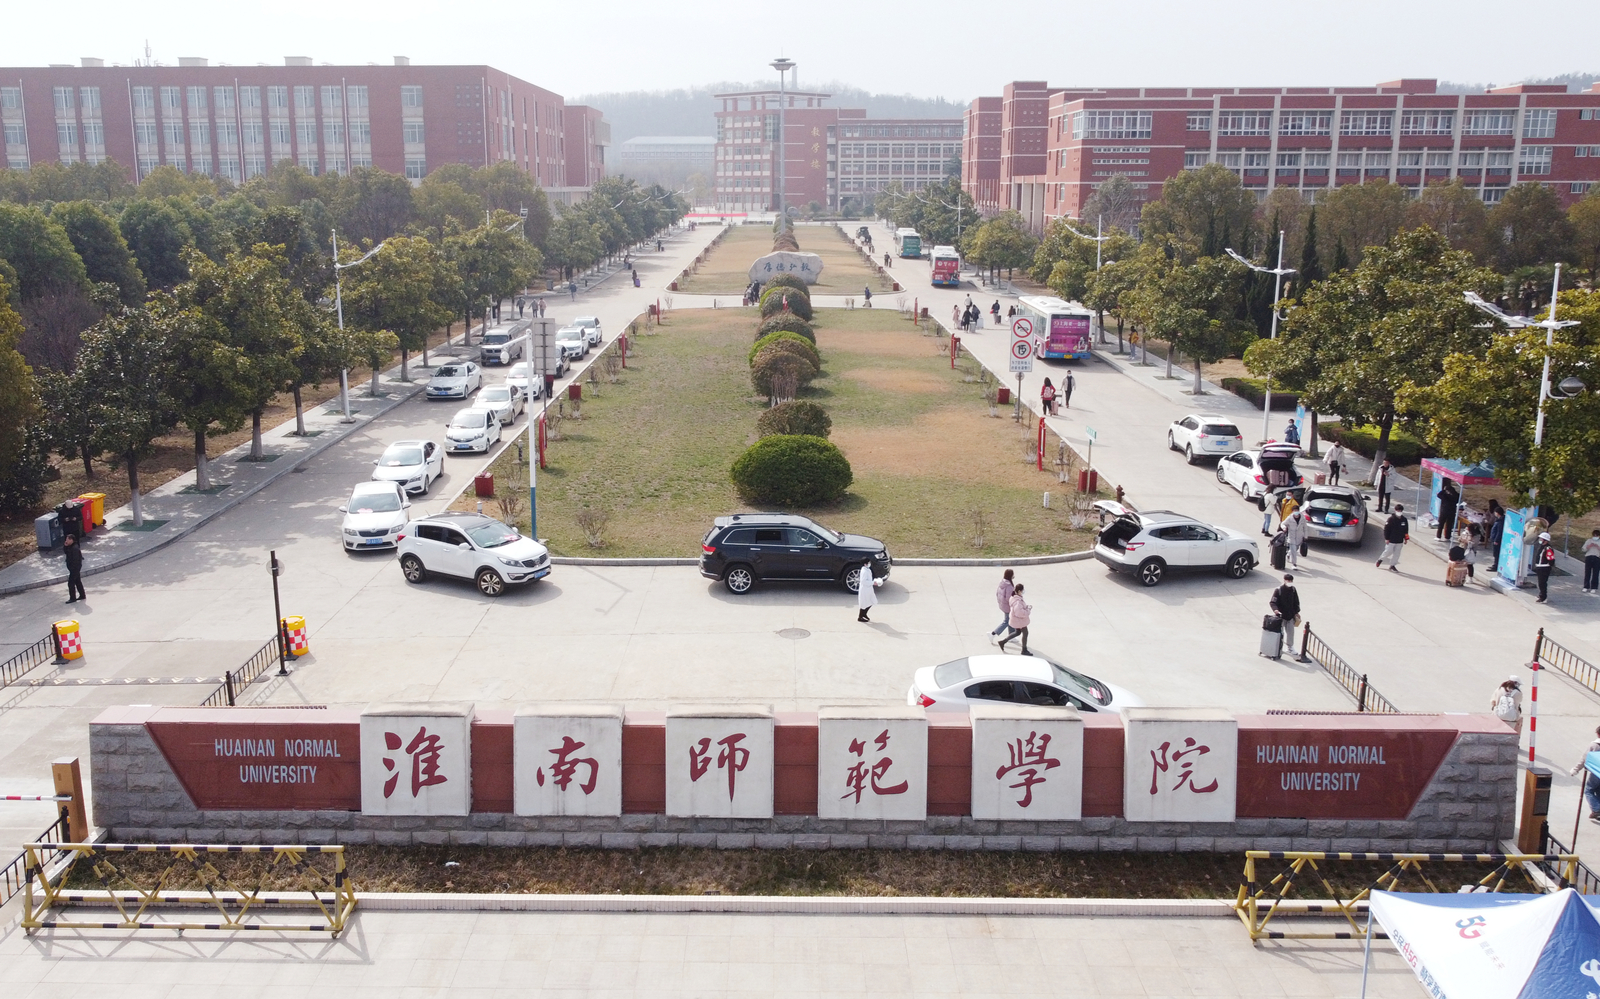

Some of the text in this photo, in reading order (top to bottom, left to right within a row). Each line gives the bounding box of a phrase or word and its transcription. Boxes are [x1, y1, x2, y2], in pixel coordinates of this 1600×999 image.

[214, 738, 341, 758] HUAINAN NORMAL
[1256, 745, 1386, 765] HUAINAN NORMAL
[239, 765, 317, 784] UNIVERSITY
[1281, 772, 1360, 791] UNIVERSITY
[1455, 915, 1487, 939] 5G
